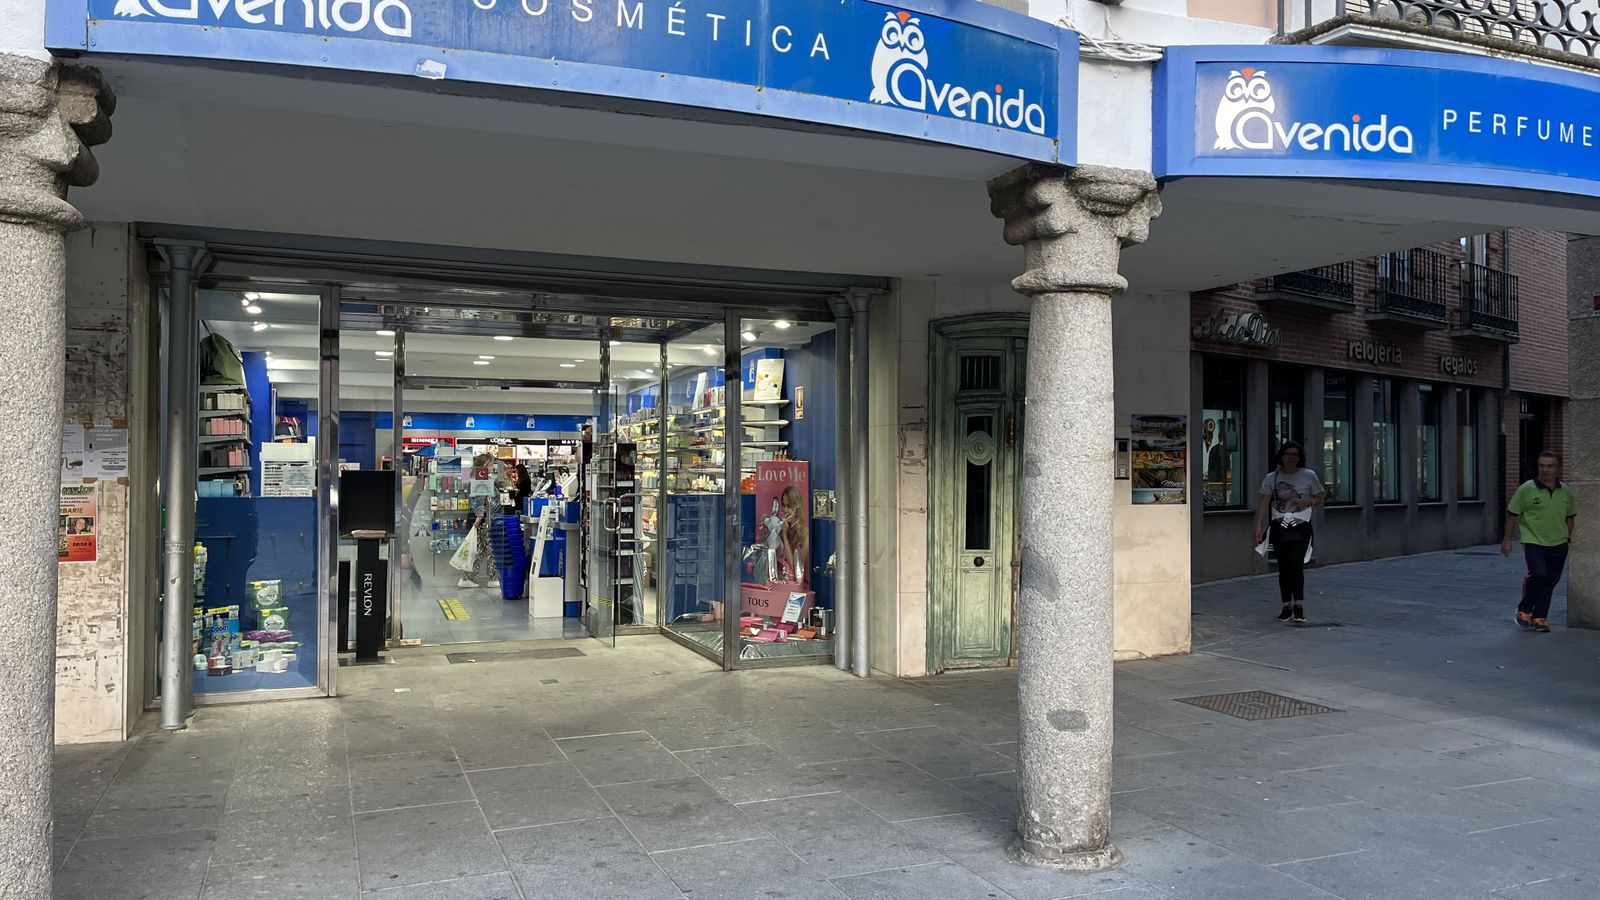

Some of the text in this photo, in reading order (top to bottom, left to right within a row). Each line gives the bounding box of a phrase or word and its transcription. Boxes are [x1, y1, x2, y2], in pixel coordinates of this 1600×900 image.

[889, 62, 1046, 135] avenida
[1236, 110, 1413, 154] avenida
[1440, 355, 1478, 378] regalos
[758, 466, 806, 482] Love Me
[363, 573, 373, 616] REVLON
[747, 597, 769, 608] TOUS
